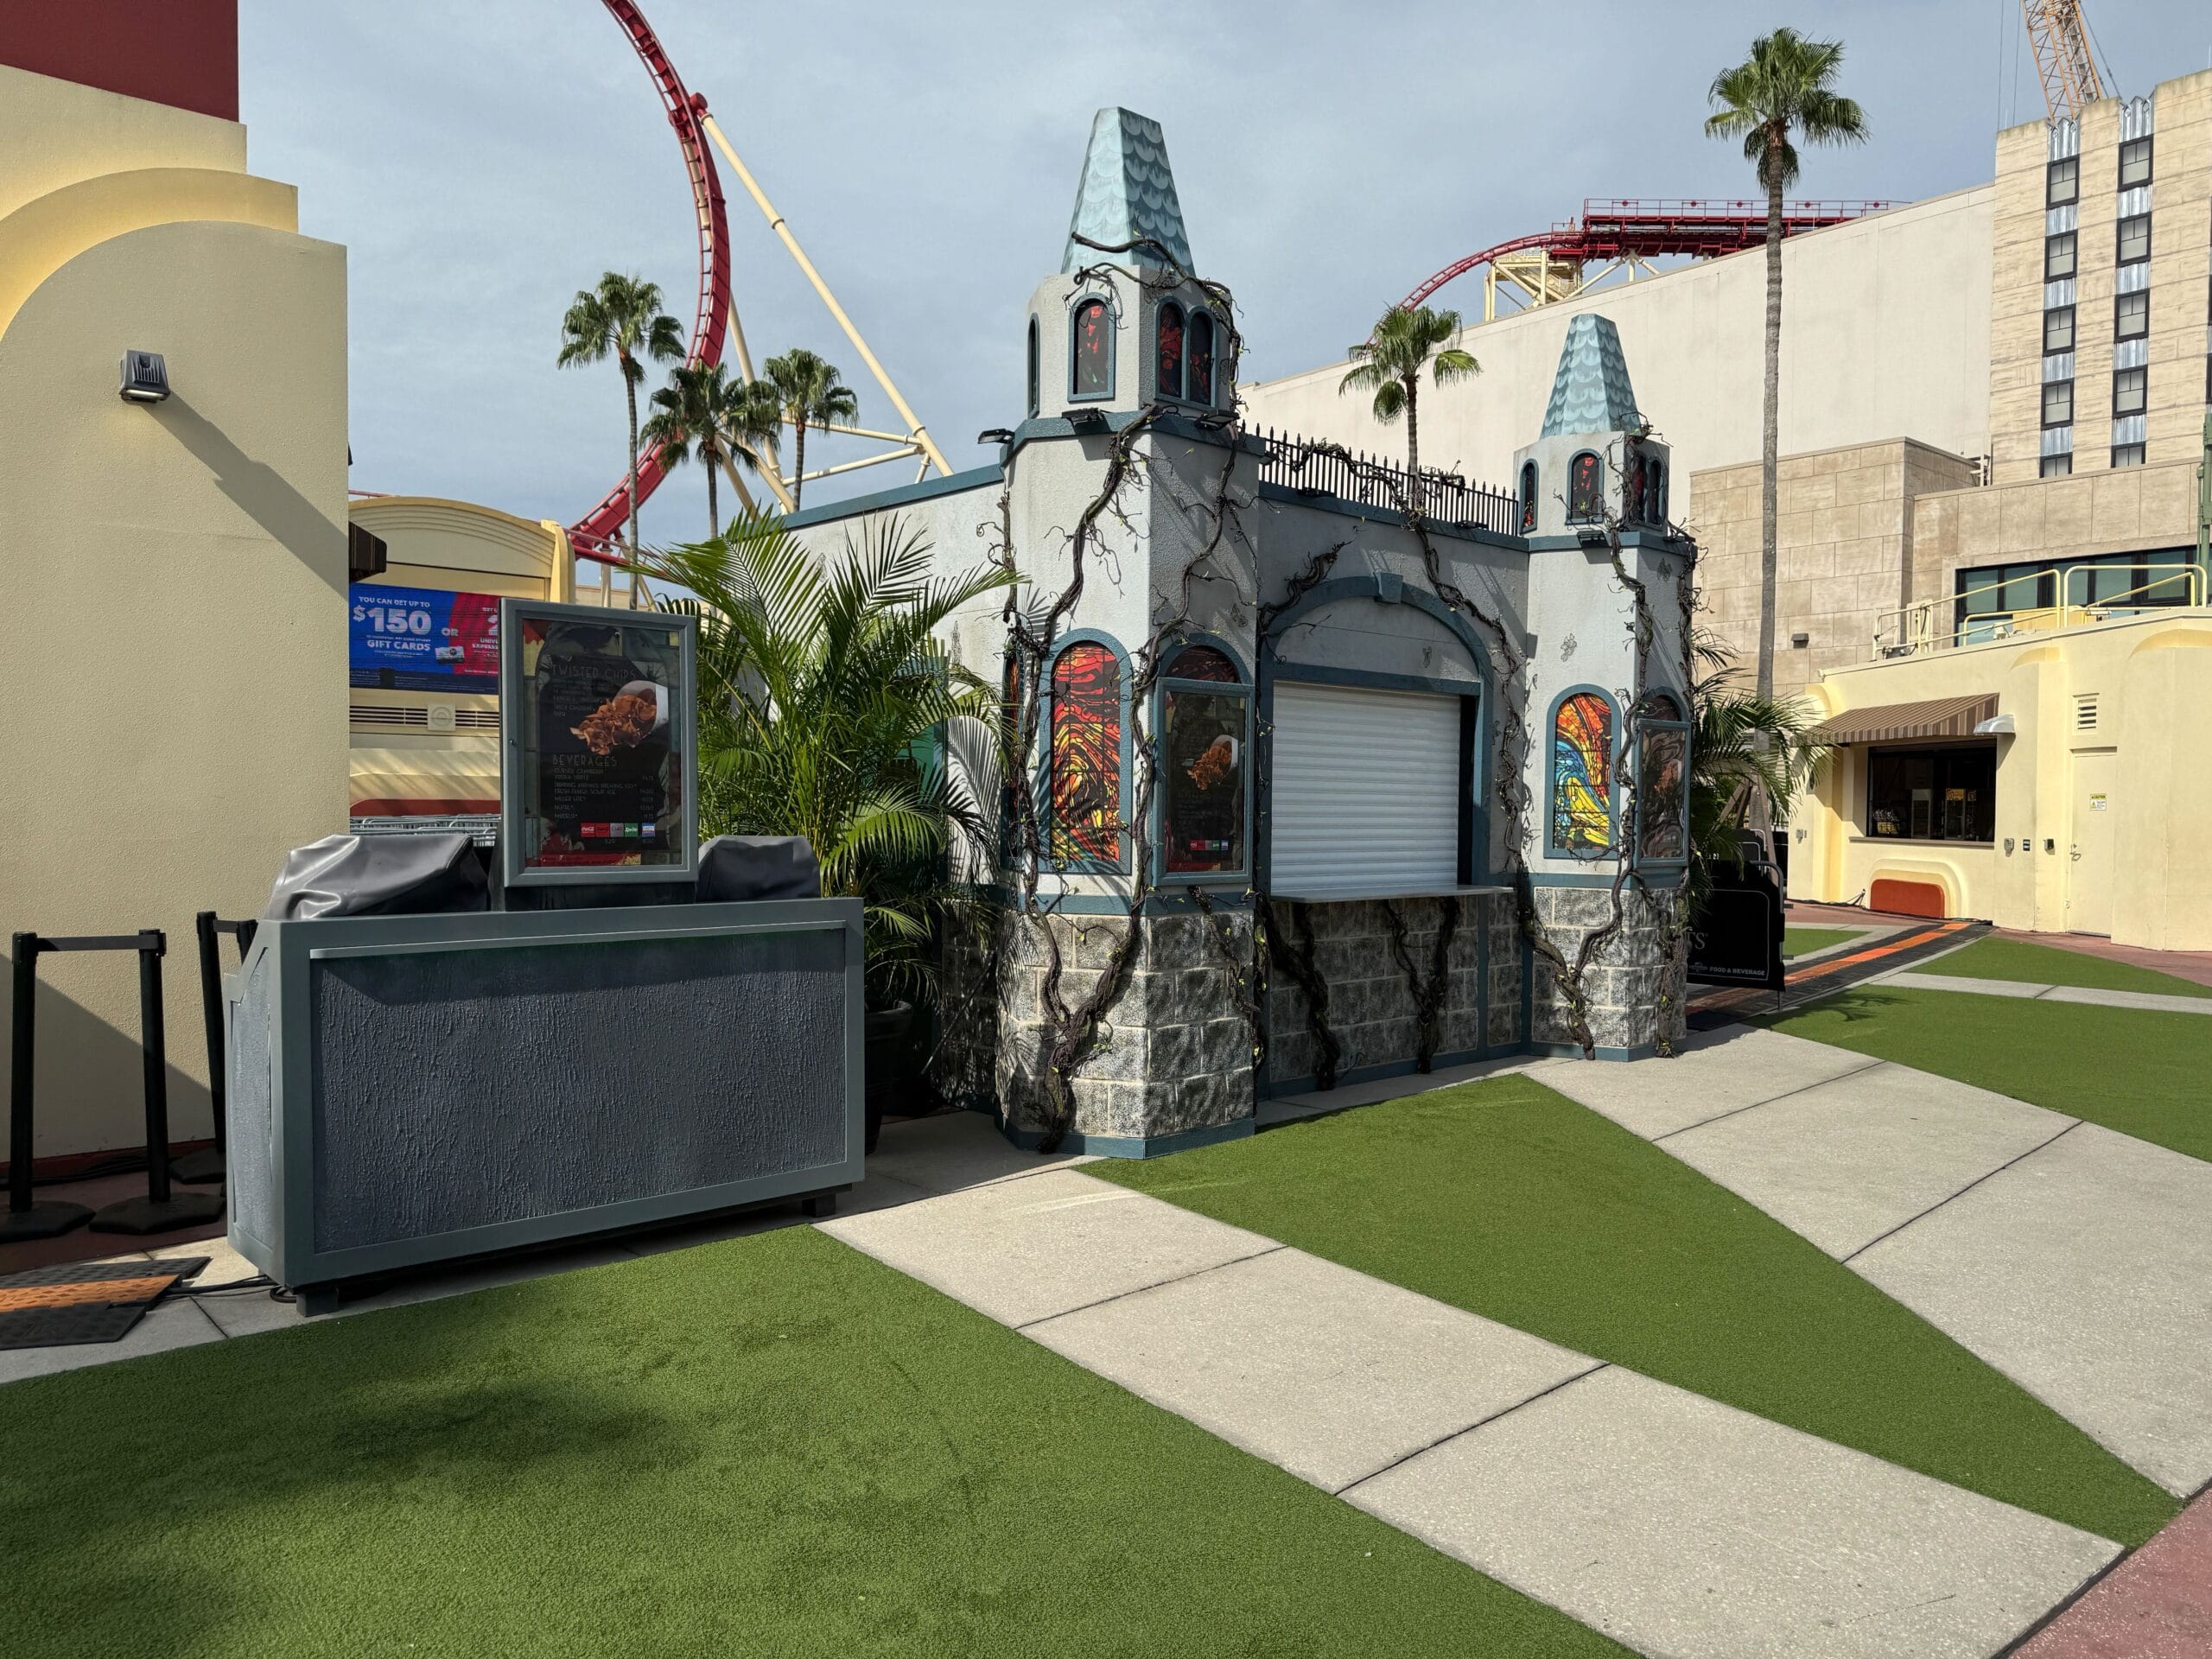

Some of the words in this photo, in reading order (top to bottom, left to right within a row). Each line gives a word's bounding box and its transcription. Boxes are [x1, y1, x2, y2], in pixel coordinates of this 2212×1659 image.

[353, 605, 432, 635] $150
[441, 627, 459, 636] OR
[367, 639, 392, 649] GIFT
[393, 641, 430, 652] CARDS
[552, 664, 600, 678] TWISTED
[605, 668, 635, 679] CHIPS
[552, 753, 618, 766] BEVERAGES
